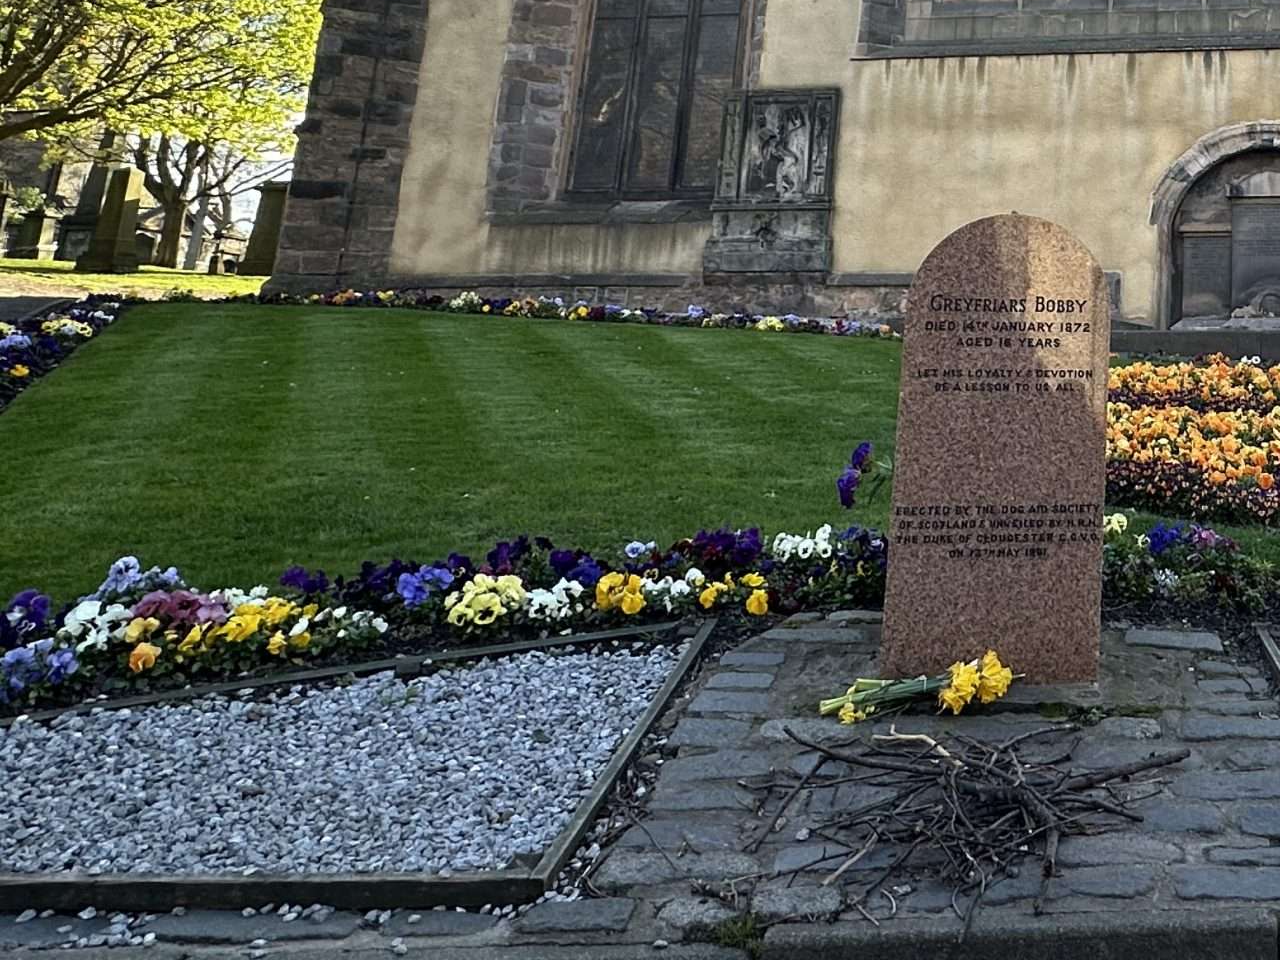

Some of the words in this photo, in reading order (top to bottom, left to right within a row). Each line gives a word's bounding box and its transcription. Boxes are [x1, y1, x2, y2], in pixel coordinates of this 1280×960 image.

[930, 294, 1026, 313] GREYFRIARS
[1035, 296, 1087, 313] BOBBY
[925, 321, 956, 331] DIED
[992, 322, 1054, 333] JANUARY
[1060, 322, 1090, 333] 1872
[956, 338, 992, 347] AGED
[1019, 338, 1060, 349] YEARS
[968, 369, 1022, 378] LOYALTY
[1036, 369, 1093, 379] DEVOTION
[965, 382, 1010, 392] LESSON
[1016, 383, 1030, 392] TO
[1036, 383, 1049, 392] US
[896, 506, 949, 515] ERECTED
[955, 506, 969, 515] BY
[976, 505, 994, 514] THE
[1052, 504, 1100, 513] SOCIETY
[900, 520, 914, 529] OF
[919, 520, 976, 529] SCOTLAND
[959, 534, 972, 543] OF
